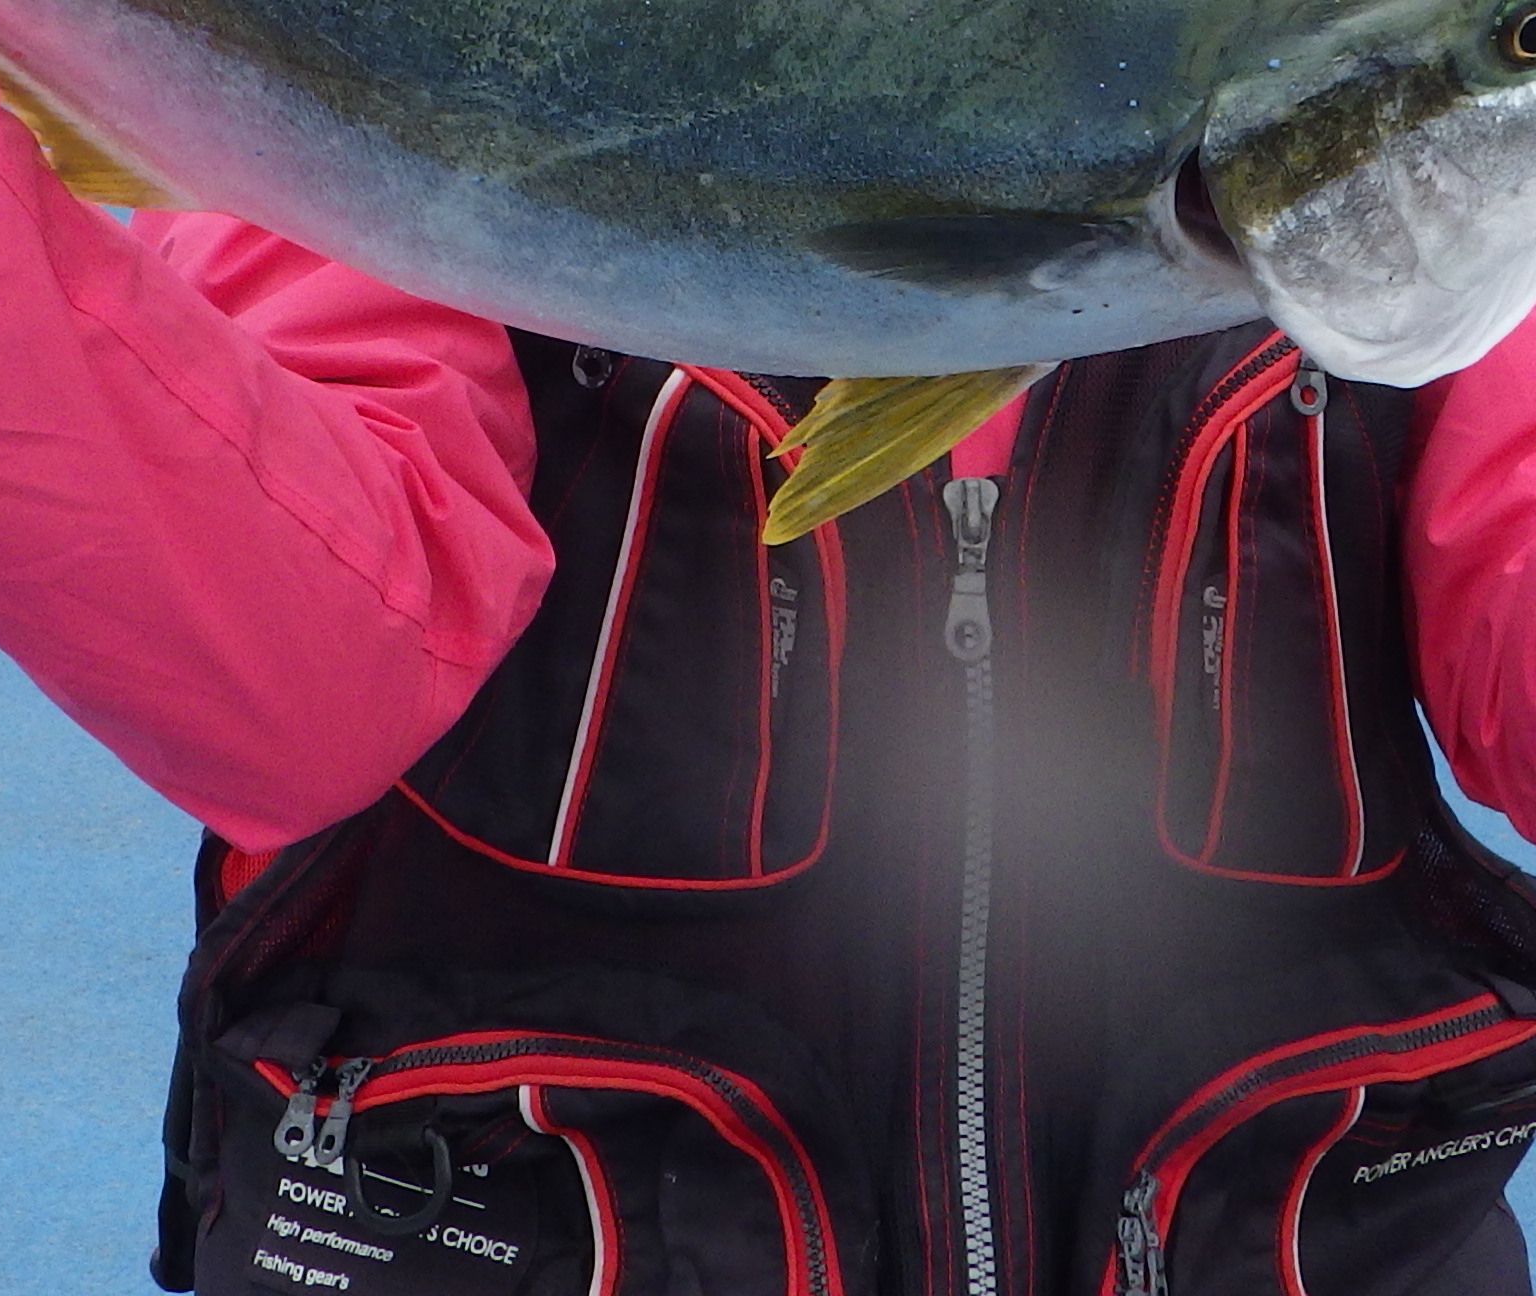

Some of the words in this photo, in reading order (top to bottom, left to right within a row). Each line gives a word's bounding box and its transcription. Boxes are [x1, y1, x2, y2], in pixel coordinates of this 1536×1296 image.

[1353, 1152, 1412, 1183] POWER
[267, 1213, 301, 1237] High
[300, 1227, 394, 1262] performance
[278, 1178, 347, 1215] POWER
[442, 1227, 519, 1265] CHOICE
[253, 1249, 305, 1282] Fishing
[305, 1266, 350, 1291] gear's
